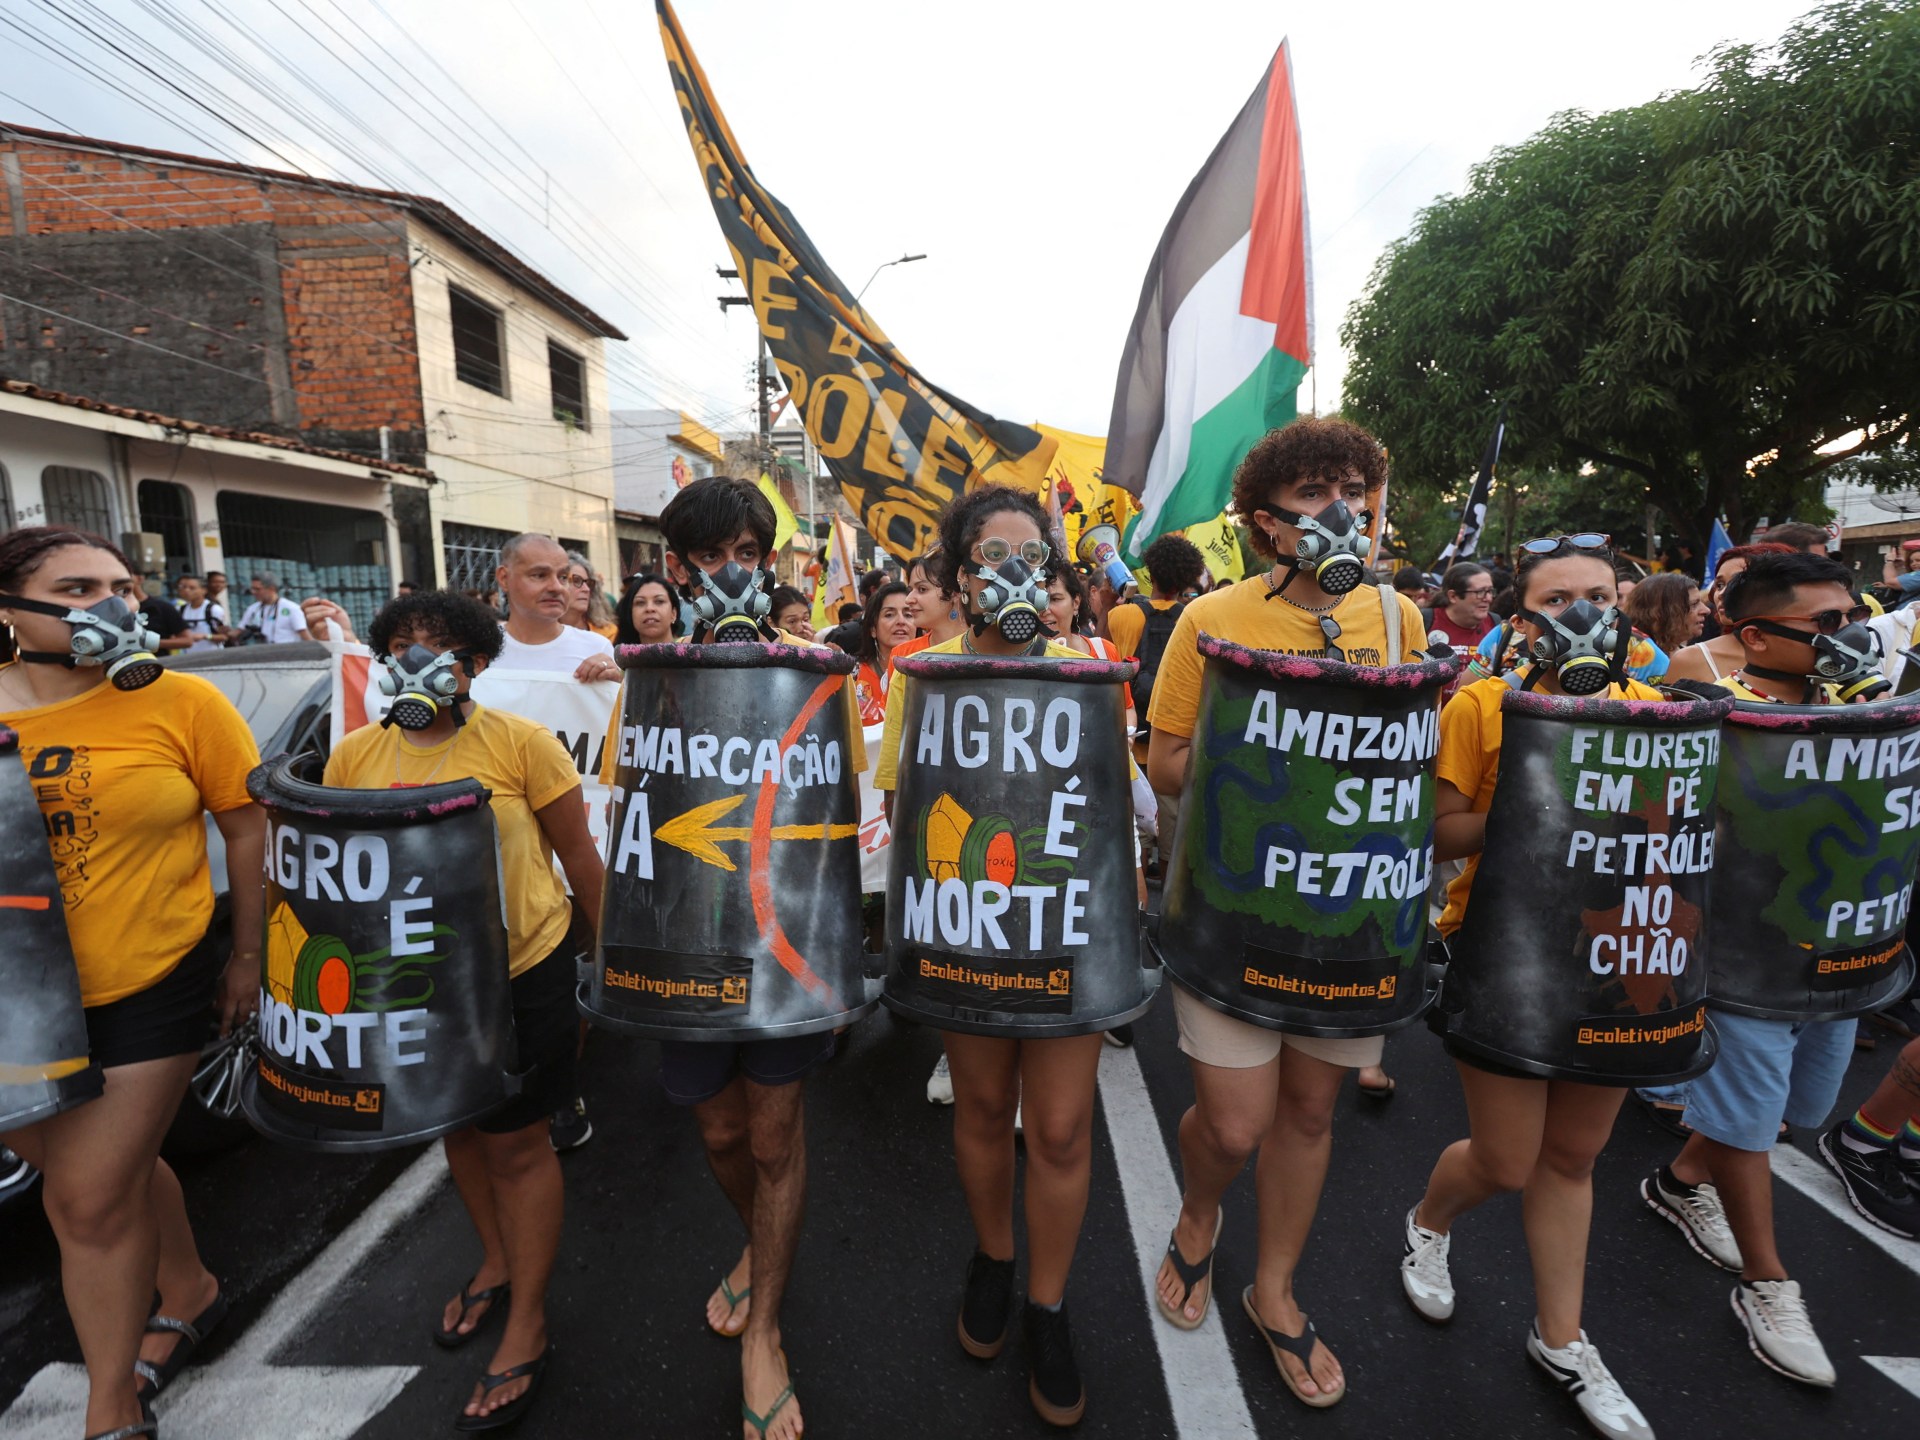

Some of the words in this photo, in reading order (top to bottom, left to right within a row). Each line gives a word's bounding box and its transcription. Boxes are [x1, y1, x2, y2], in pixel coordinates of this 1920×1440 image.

[917, 694, 1081, 773] AGRO
[617, 724, 841, 799] EMARCAÇÃO
[1044, 774, 1087, 858] É
[1326, 775, 1422, 826] SEM
[1574, 771, 1635, 814] EM
[1666, 768, 1702, 820] PÉ
[1881, 785, 1920, 834] SE
[263, 818, 390, 902] AGRO
[987, 857, 1015, 868] TOXIC
[1264, 844, 1435, 900] PETRÓLE
[389, 876, 435, 957] É
[903, 876, 1091, 952] MORTE
[1621, 885, 1673, 927] NO
[1826, 880, 1914, 939] PETR
[920, 959, 1044, 991] @coletivojuntos
[1589, 927, 1688, 976] CHÃO
[605, 967, 718, 998] @coletivojuntos
[1244, 967, 1375, 999] @coletivojuntos
[259, 986, 428, 1068] MORTE
[1577, 1020, 1694, 1045] @coletivojuntos
